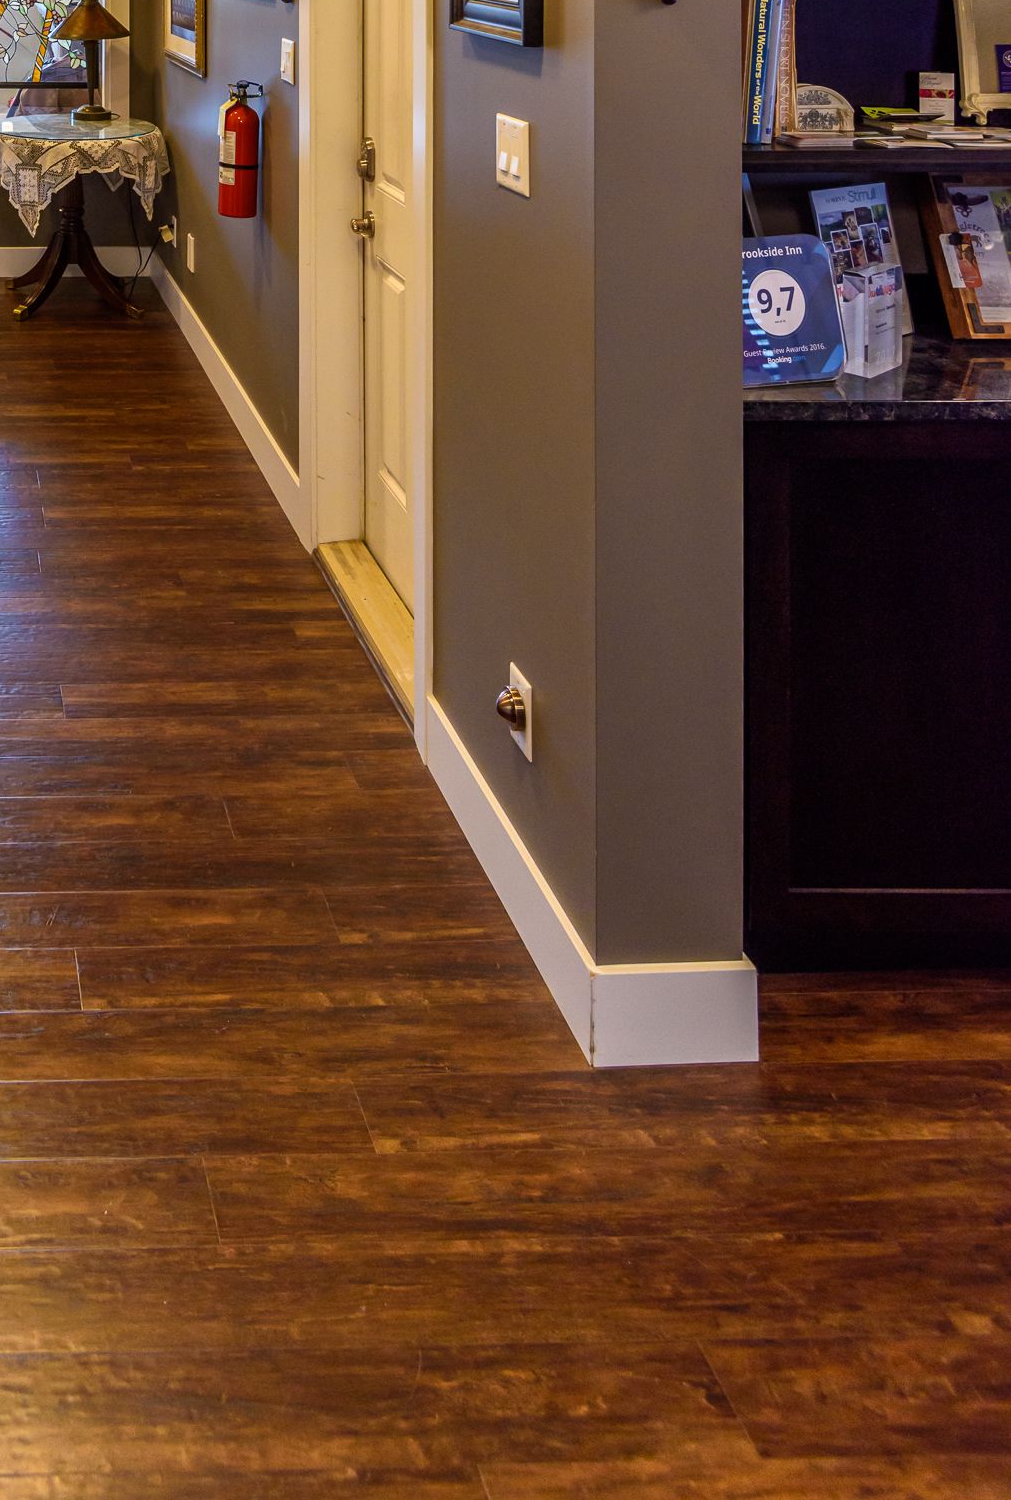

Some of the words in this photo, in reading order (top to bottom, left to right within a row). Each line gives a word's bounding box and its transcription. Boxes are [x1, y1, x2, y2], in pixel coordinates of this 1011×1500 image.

[755, 34, 766, 79] Wonders
[752, 95, 762, 125] World
[780, 76, 791, 124] NOVELS
[741, 246, 784, 259] rookside
[785, 245, 803, 256] Inn
[756, 286, 795, 317] 9,7
[743, 349, 762, 358] Guest
[762, 348, 785, 356] Riew
[785, 344, 809, 354] Awards
